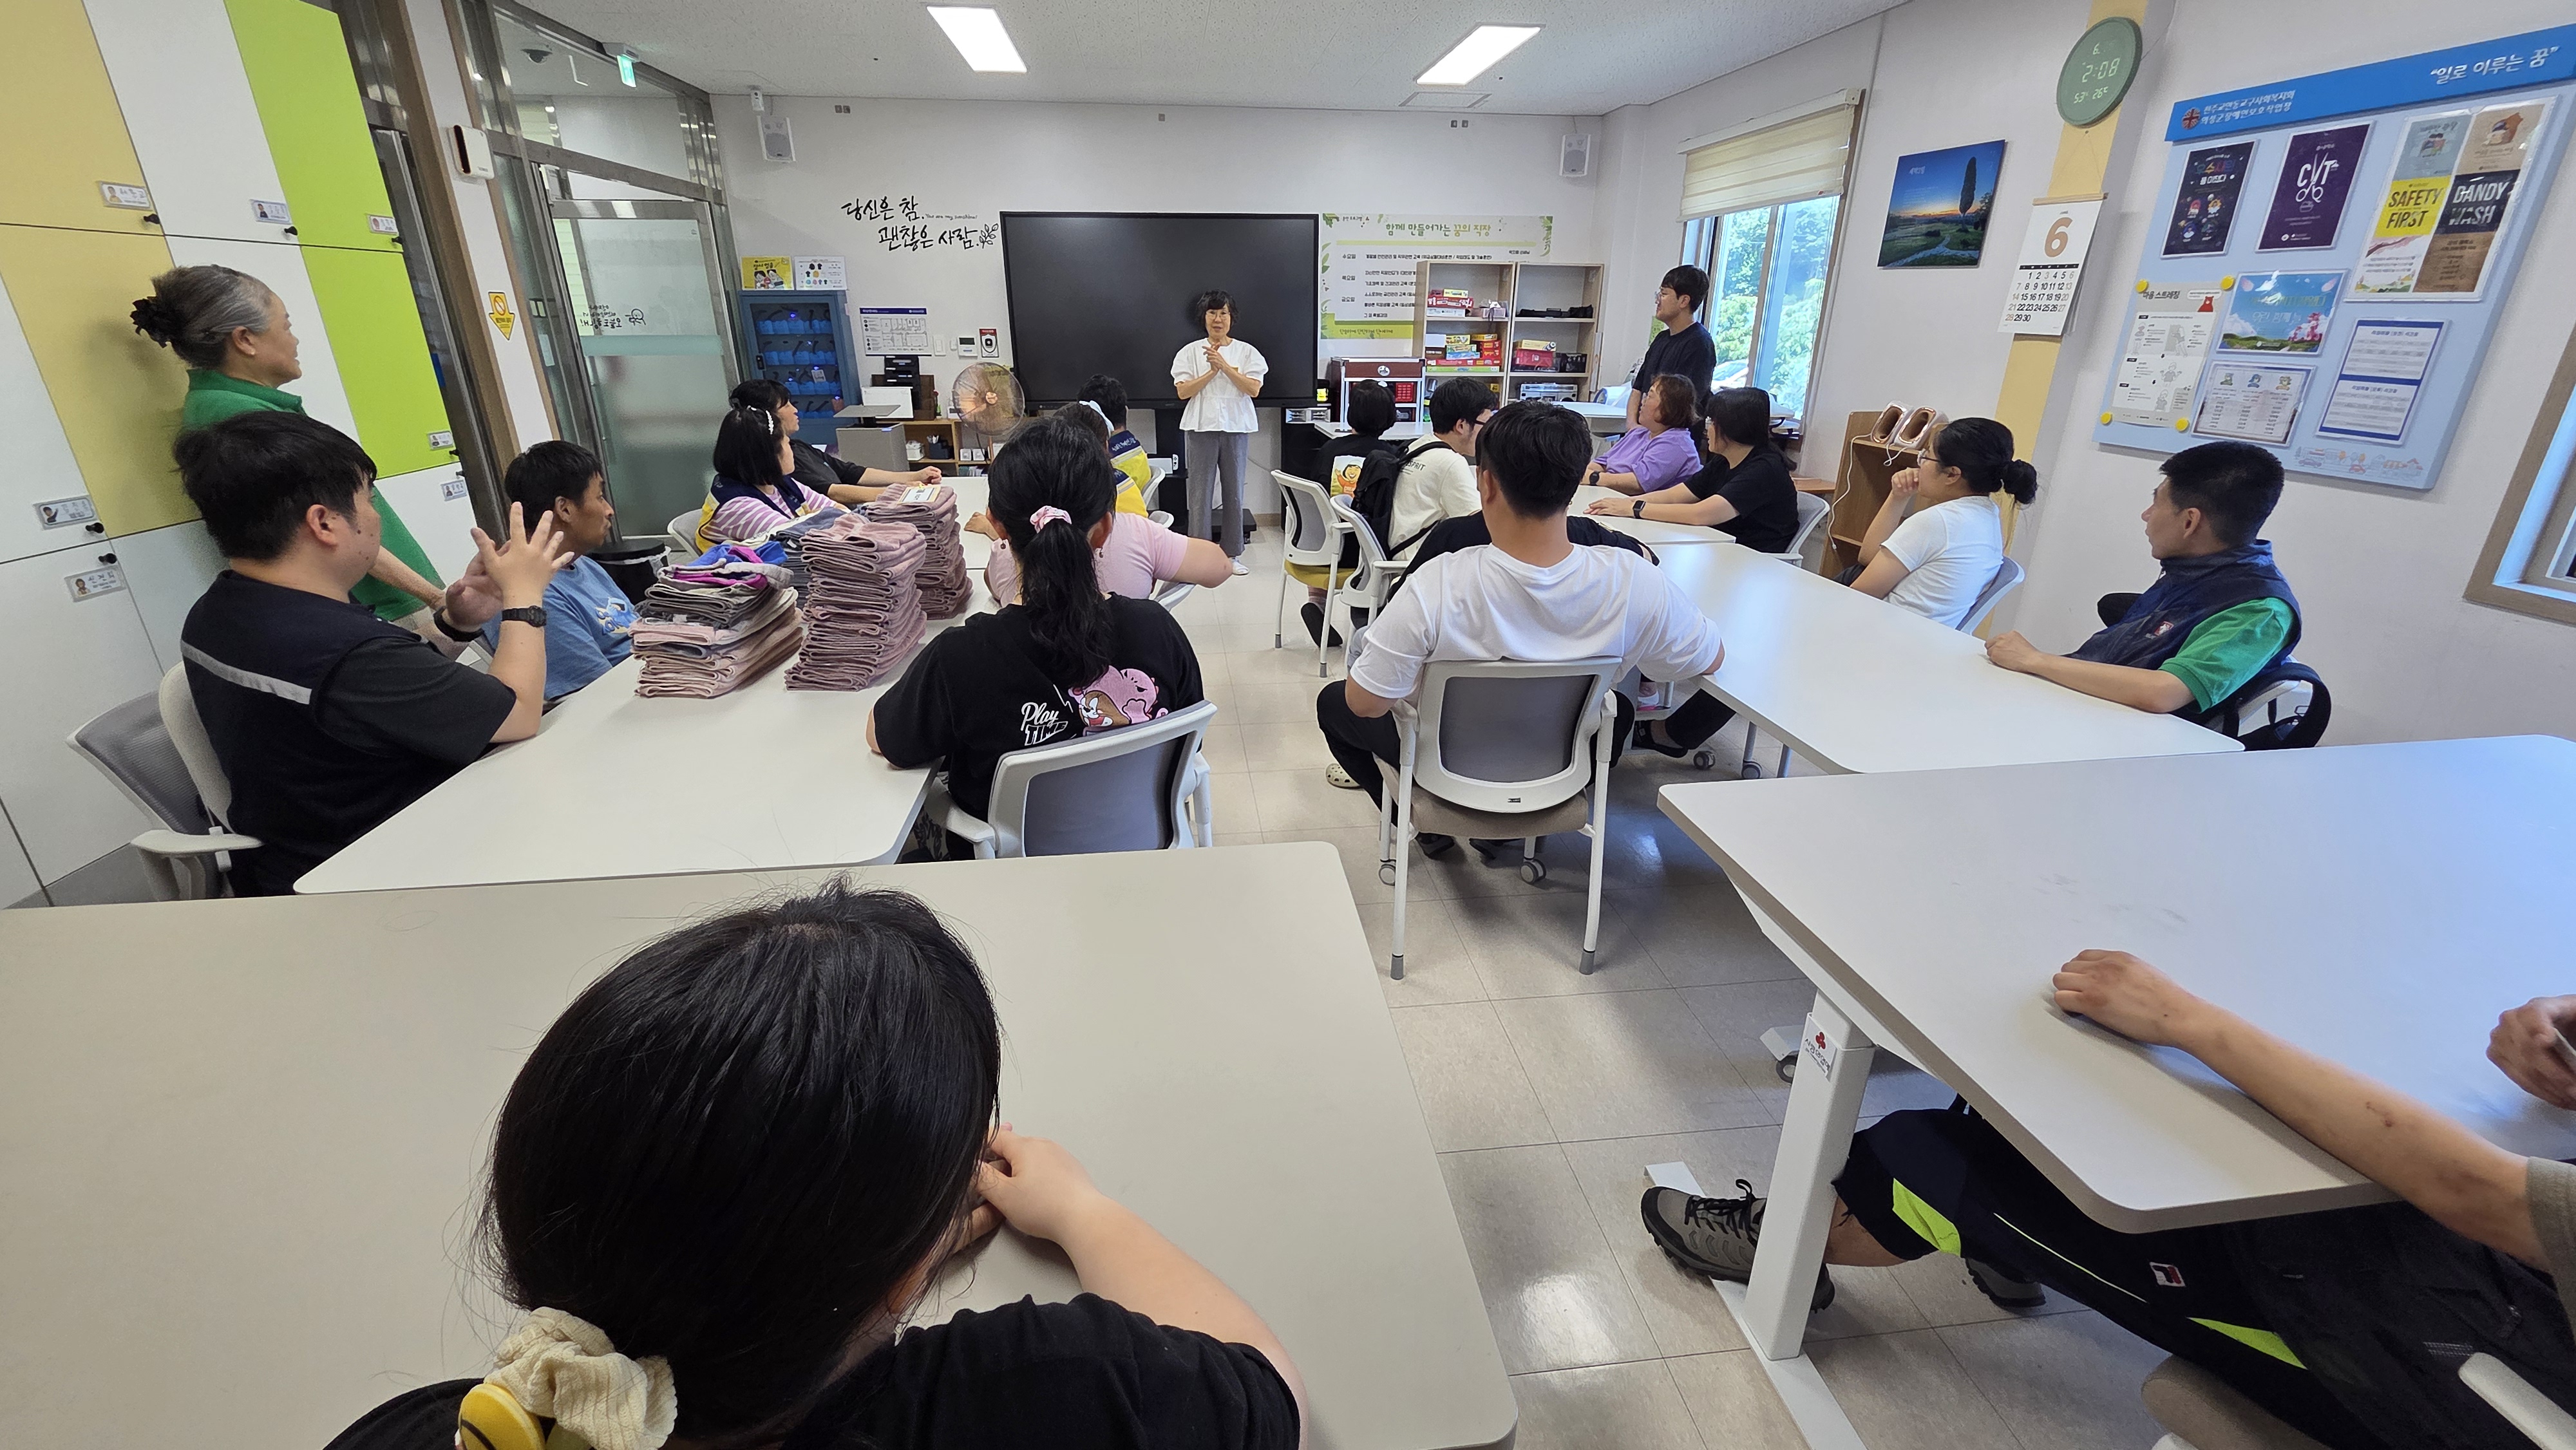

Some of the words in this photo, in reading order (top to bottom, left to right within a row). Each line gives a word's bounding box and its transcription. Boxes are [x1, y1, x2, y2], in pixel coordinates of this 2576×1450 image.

[2082, 58, 2121, 83] 2:08
[2473, 54, 2524, 75] 이루는
[2388, 187, 2444, 208] SAFETY
[2452, 182, 2509, 203] DANDY
[841, 196, 895, 220] 당신은
[898, 195, 925, 221] 참.
[2449, 205, 2497, 225] WASH
[1385, 223, 1405, 236] 함께
[1408, 223, 1451, 237] 만들어가는
[1454, 224, 1471, 237] 꿈의
[1473, 225, 1491, 236] 직장
[2386, 211, 2429, 229] FIRST
[878, 225, 934, 251] 괜찮은
[2044, 217, 2073, 258] 6
[2061, 271, 2067, 279] 5
[2041, 282, 2048, 290] 10
[2049, 282, 2056, 290] 11
[2058, 282, 2065, 290] 12
[2065, 282, 2072, 290] 13
[2054, 293, 2061, 301] 19
[2061, 293, 2069, 301] 20
[2058, 304, 2066, 312] 27
[1020, 702, 1059, 731] Play
